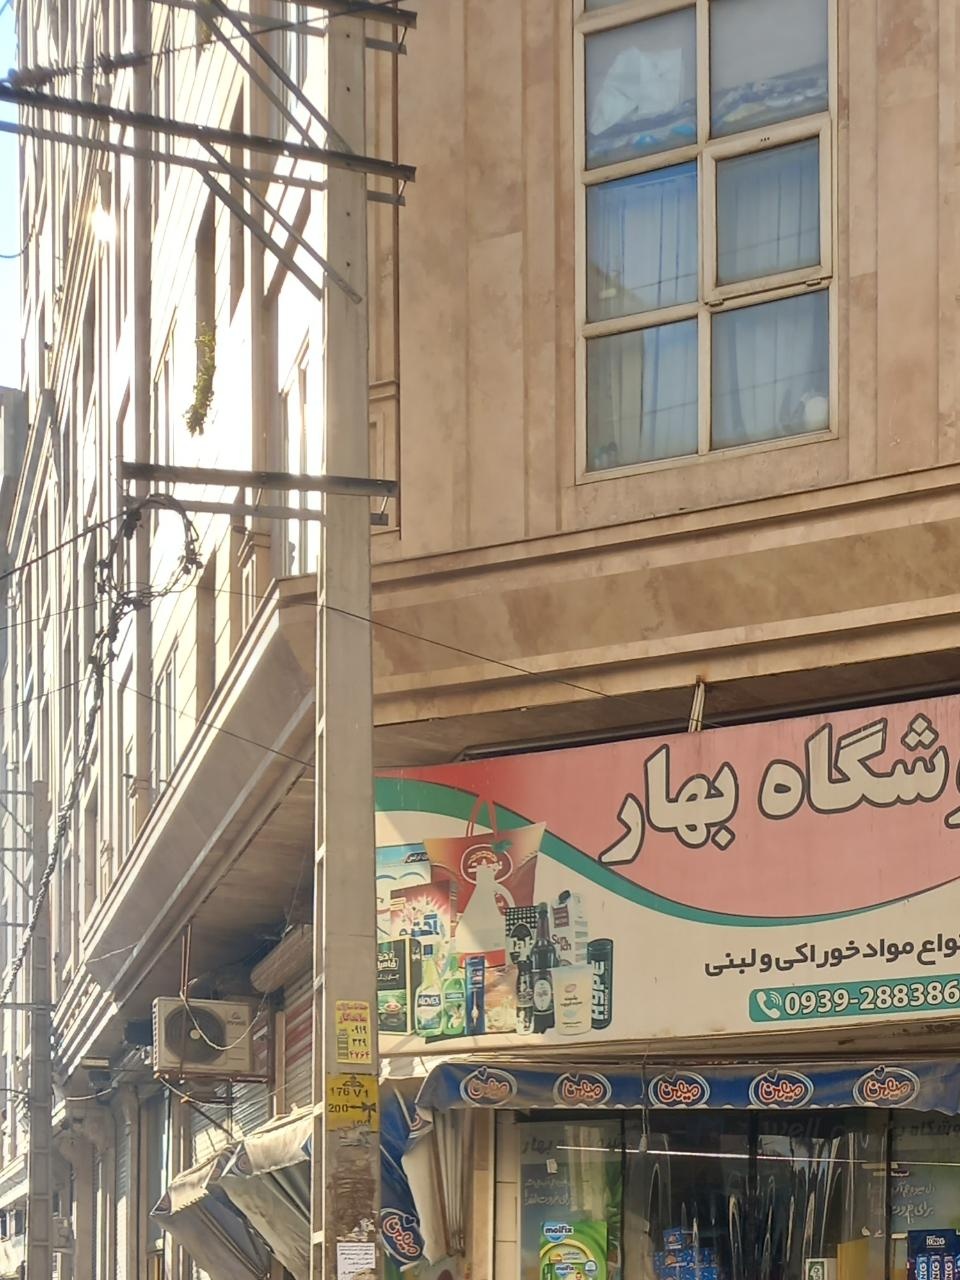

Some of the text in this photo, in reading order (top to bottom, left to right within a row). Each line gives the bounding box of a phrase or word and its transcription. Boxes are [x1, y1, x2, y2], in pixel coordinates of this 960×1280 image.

[598, 742, 739, 866] بهار
[704, 948, 756, 977] لبنی
[759, 951, 773, 973] و
[774, 937, 861, 968] خوراکی
[862, 938, 915, 962] مواد
[545, 1225, 573, 1235] molfix
